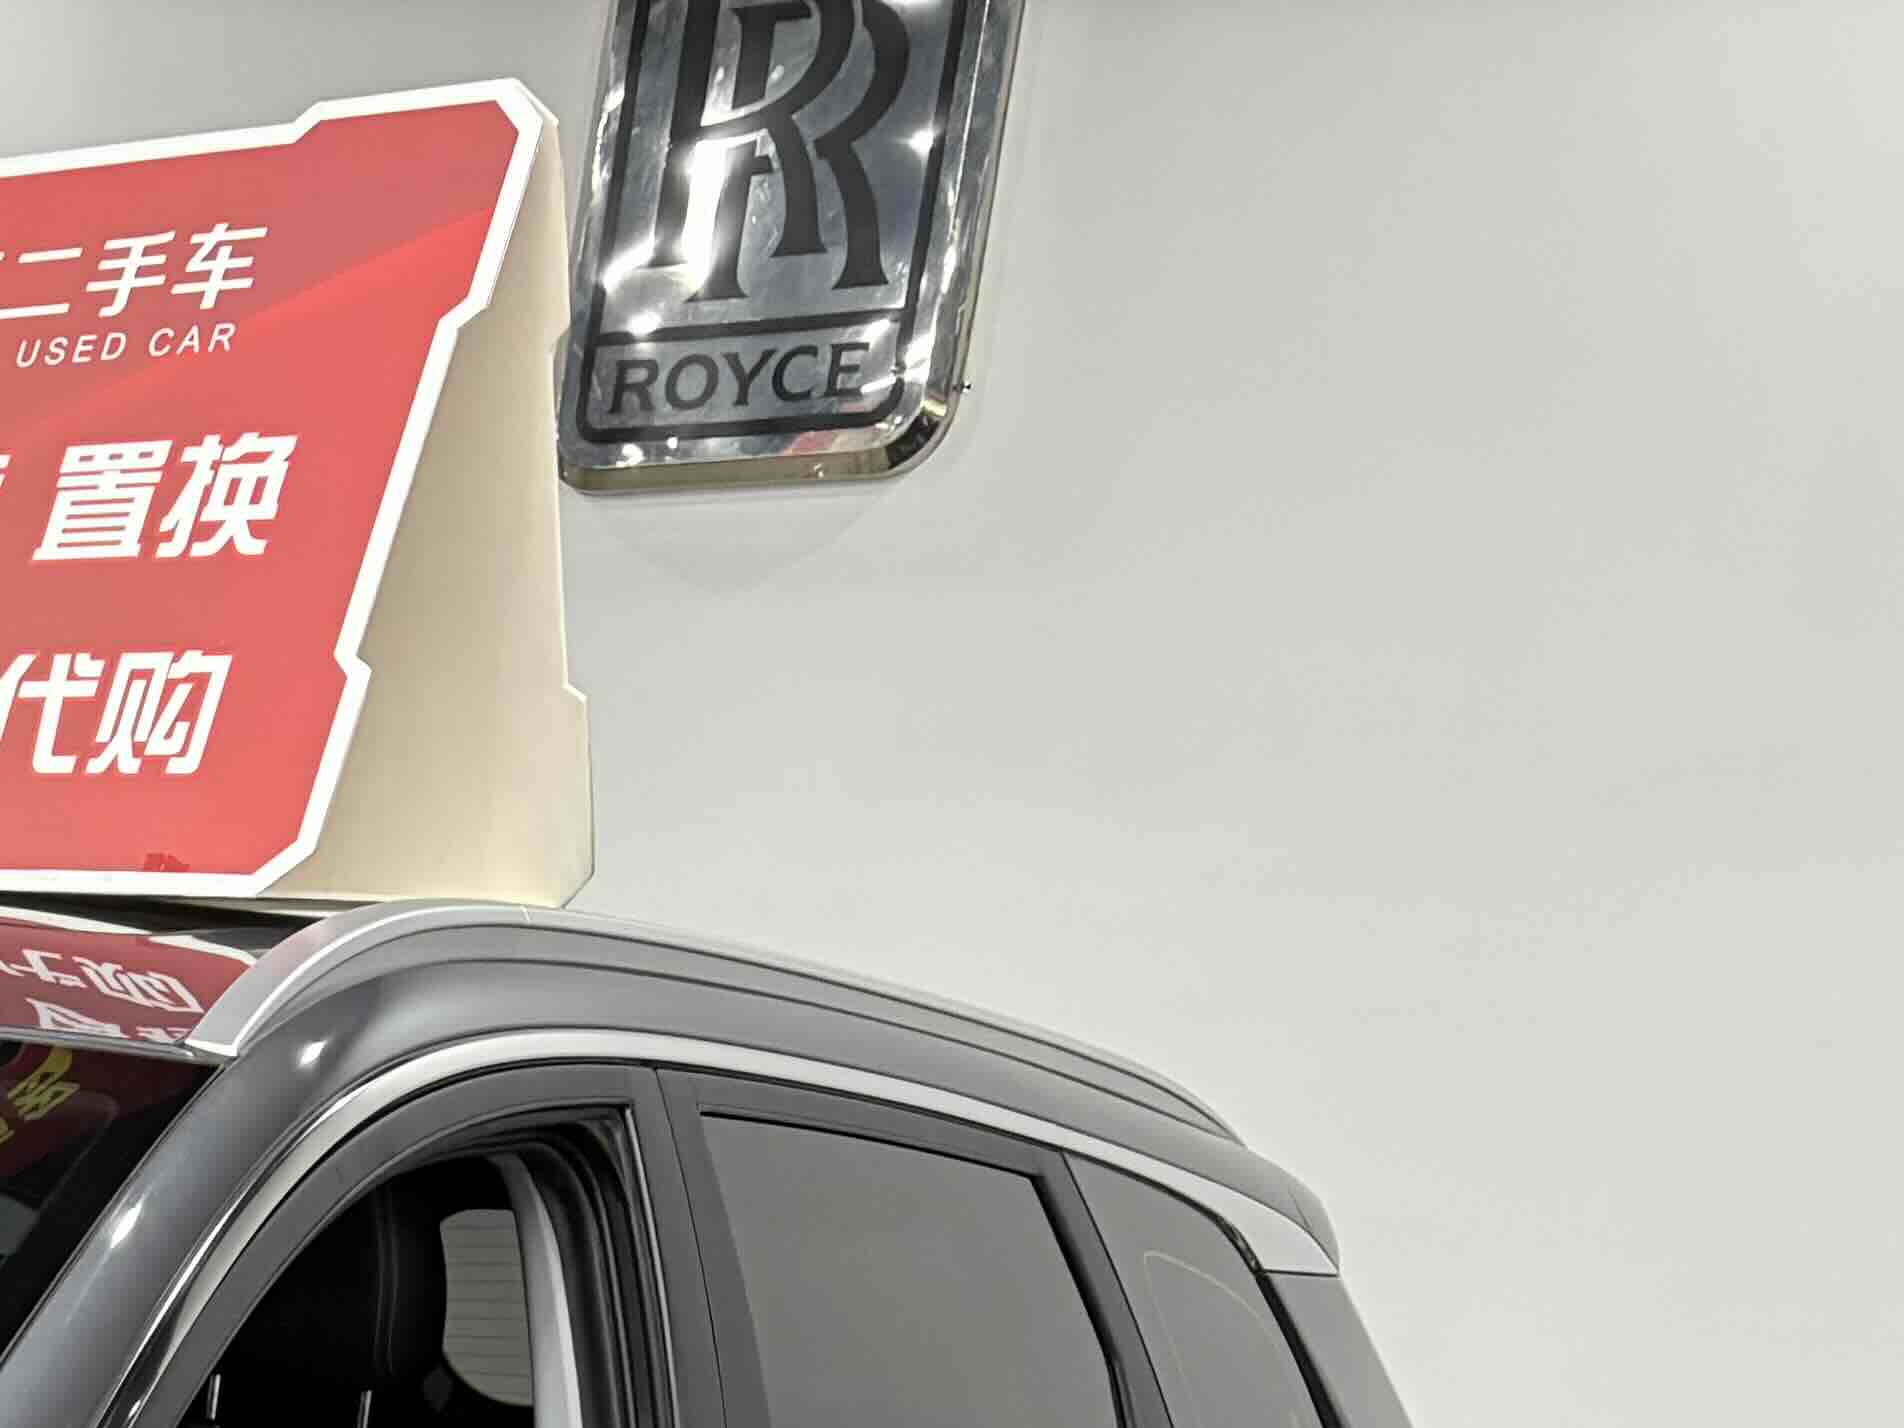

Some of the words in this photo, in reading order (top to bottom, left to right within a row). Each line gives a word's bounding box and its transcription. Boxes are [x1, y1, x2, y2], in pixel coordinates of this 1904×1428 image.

[15, 332, 129, 368] USED
[148, 322, 237, 356] CAR
[607, 342, 870, 415] ROYCE
[31, 433, 298, 564] 置换
